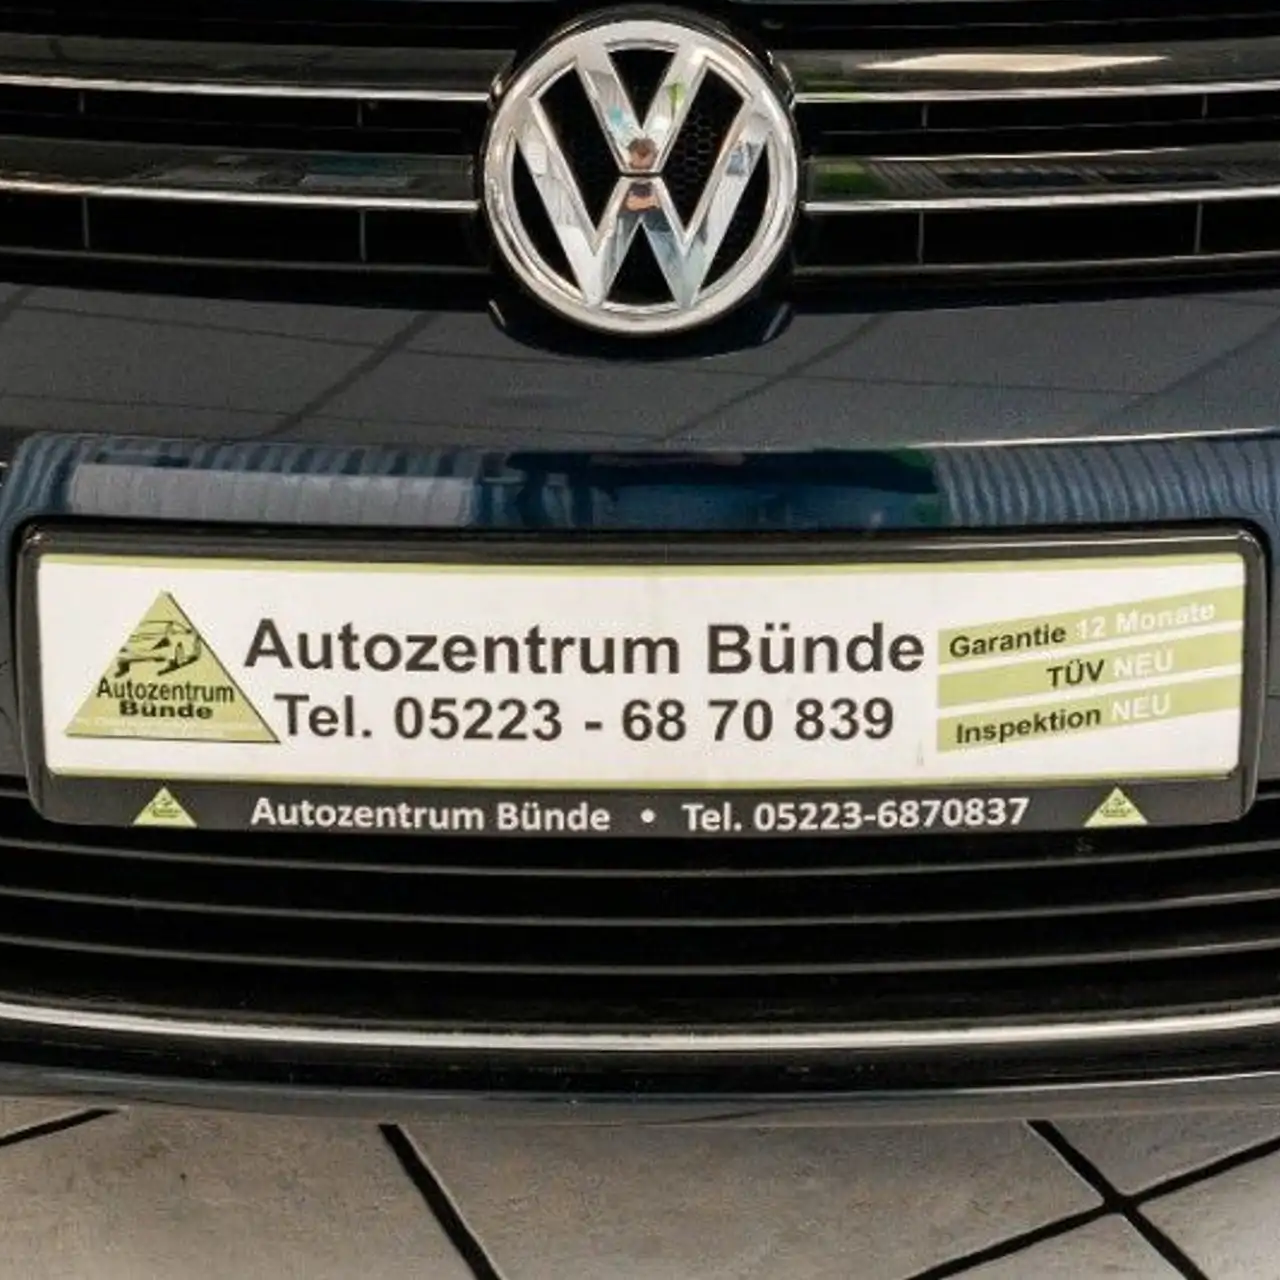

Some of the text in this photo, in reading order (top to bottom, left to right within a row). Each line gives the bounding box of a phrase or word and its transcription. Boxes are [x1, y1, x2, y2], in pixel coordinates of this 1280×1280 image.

[244, 618, 925, 675] Autozentrum Bünde
[949, 602, 1215, 658] Garantie 12 Monate
[1046, 649, 1174, 687] TÜV NEU
[96, 677, 235, 703] Autozentrum
[119, 700, 213, 719] Bünde
[274, 693, 372, 737] Tel.
[394, 696, 562, 741] 05223
[622, 698, 687, 741] 68
[709, 698, 773, 741] 70
[795, 697, 894, 741] 839
[956, 692, 1170, 743] Inspektion NEU
[250, 797, 1030, 831] Autozentrum Bünde Tel. 05223-6870837
